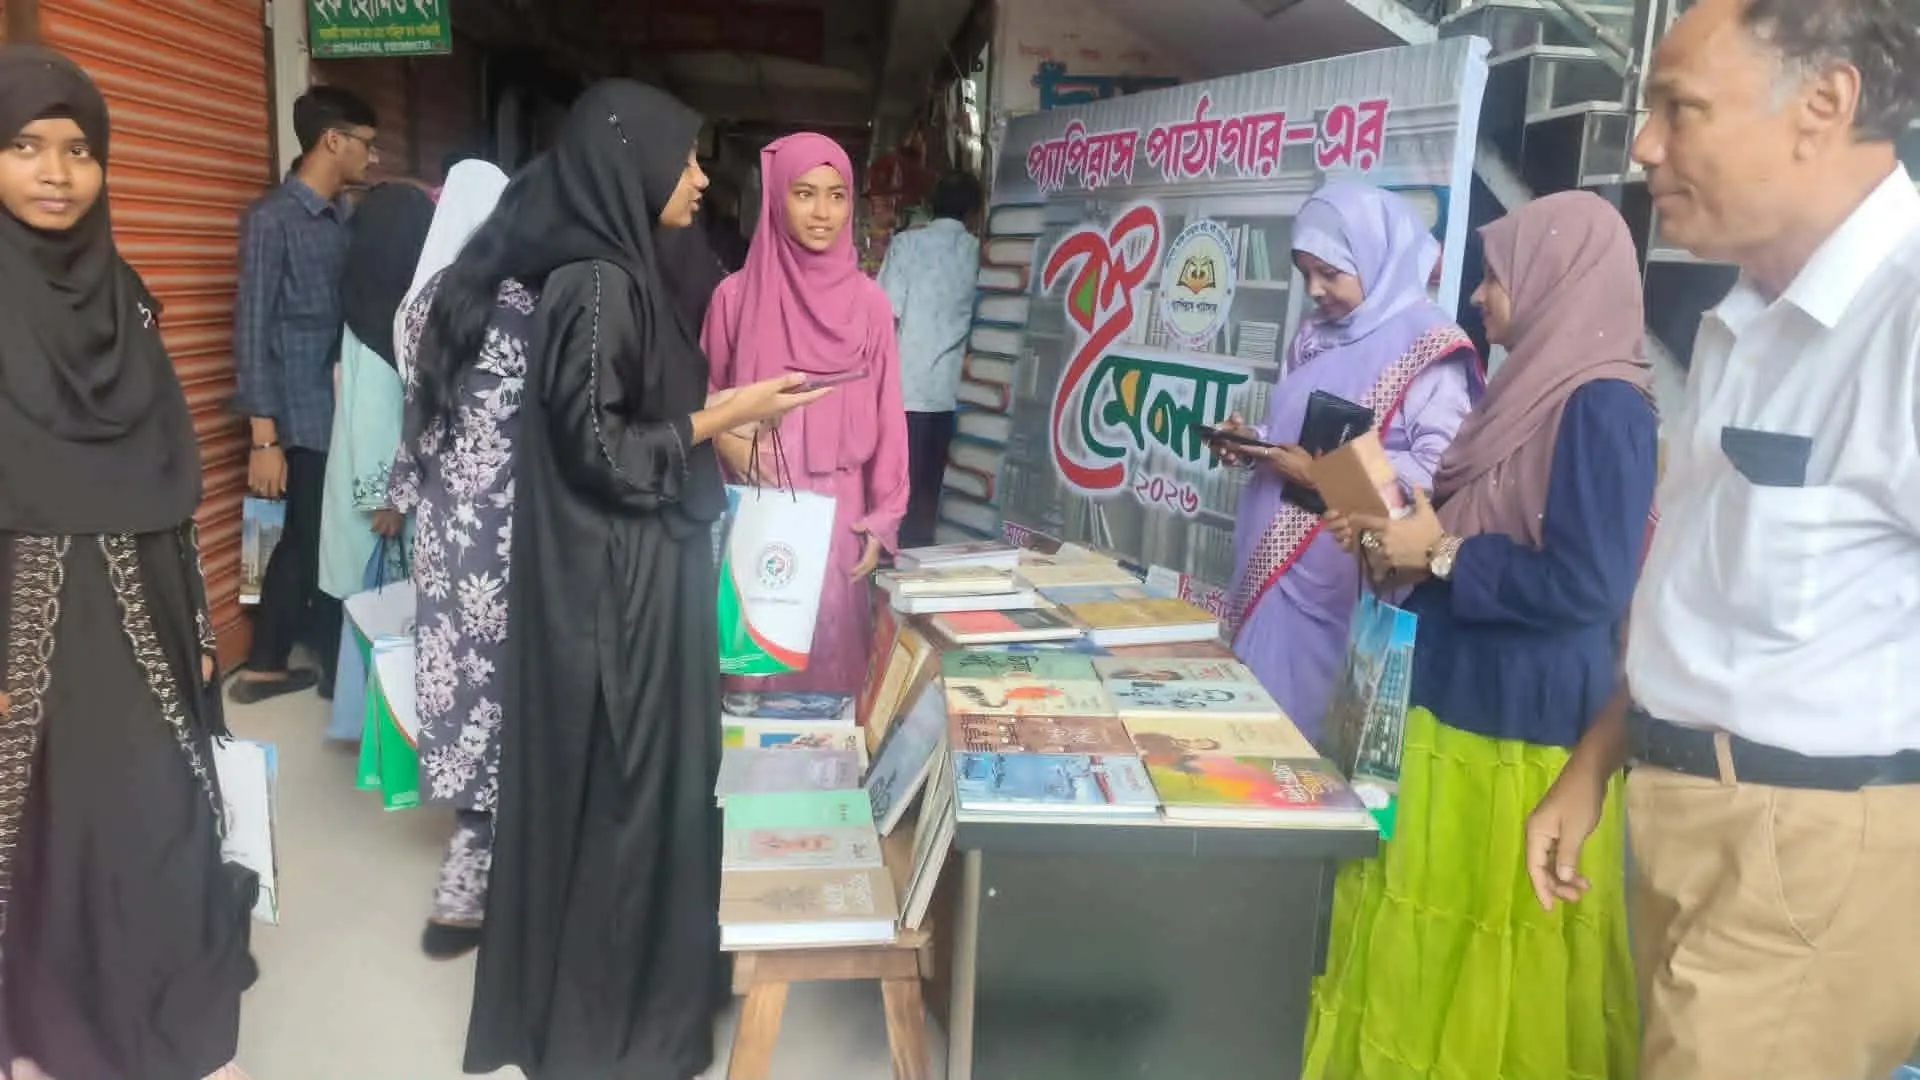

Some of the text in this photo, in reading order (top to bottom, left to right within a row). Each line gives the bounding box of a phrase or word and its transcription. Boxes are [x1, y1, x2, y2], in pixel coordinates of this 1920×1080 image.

[1028, 93, 1390, 192] প্যাপিরাস পাঠাগার-এর
[1043, 205, 1160, 489] বই
[1081, 354, 1250, 470] মেলা
[1135, 471, 1199, 513] ২০২৬
